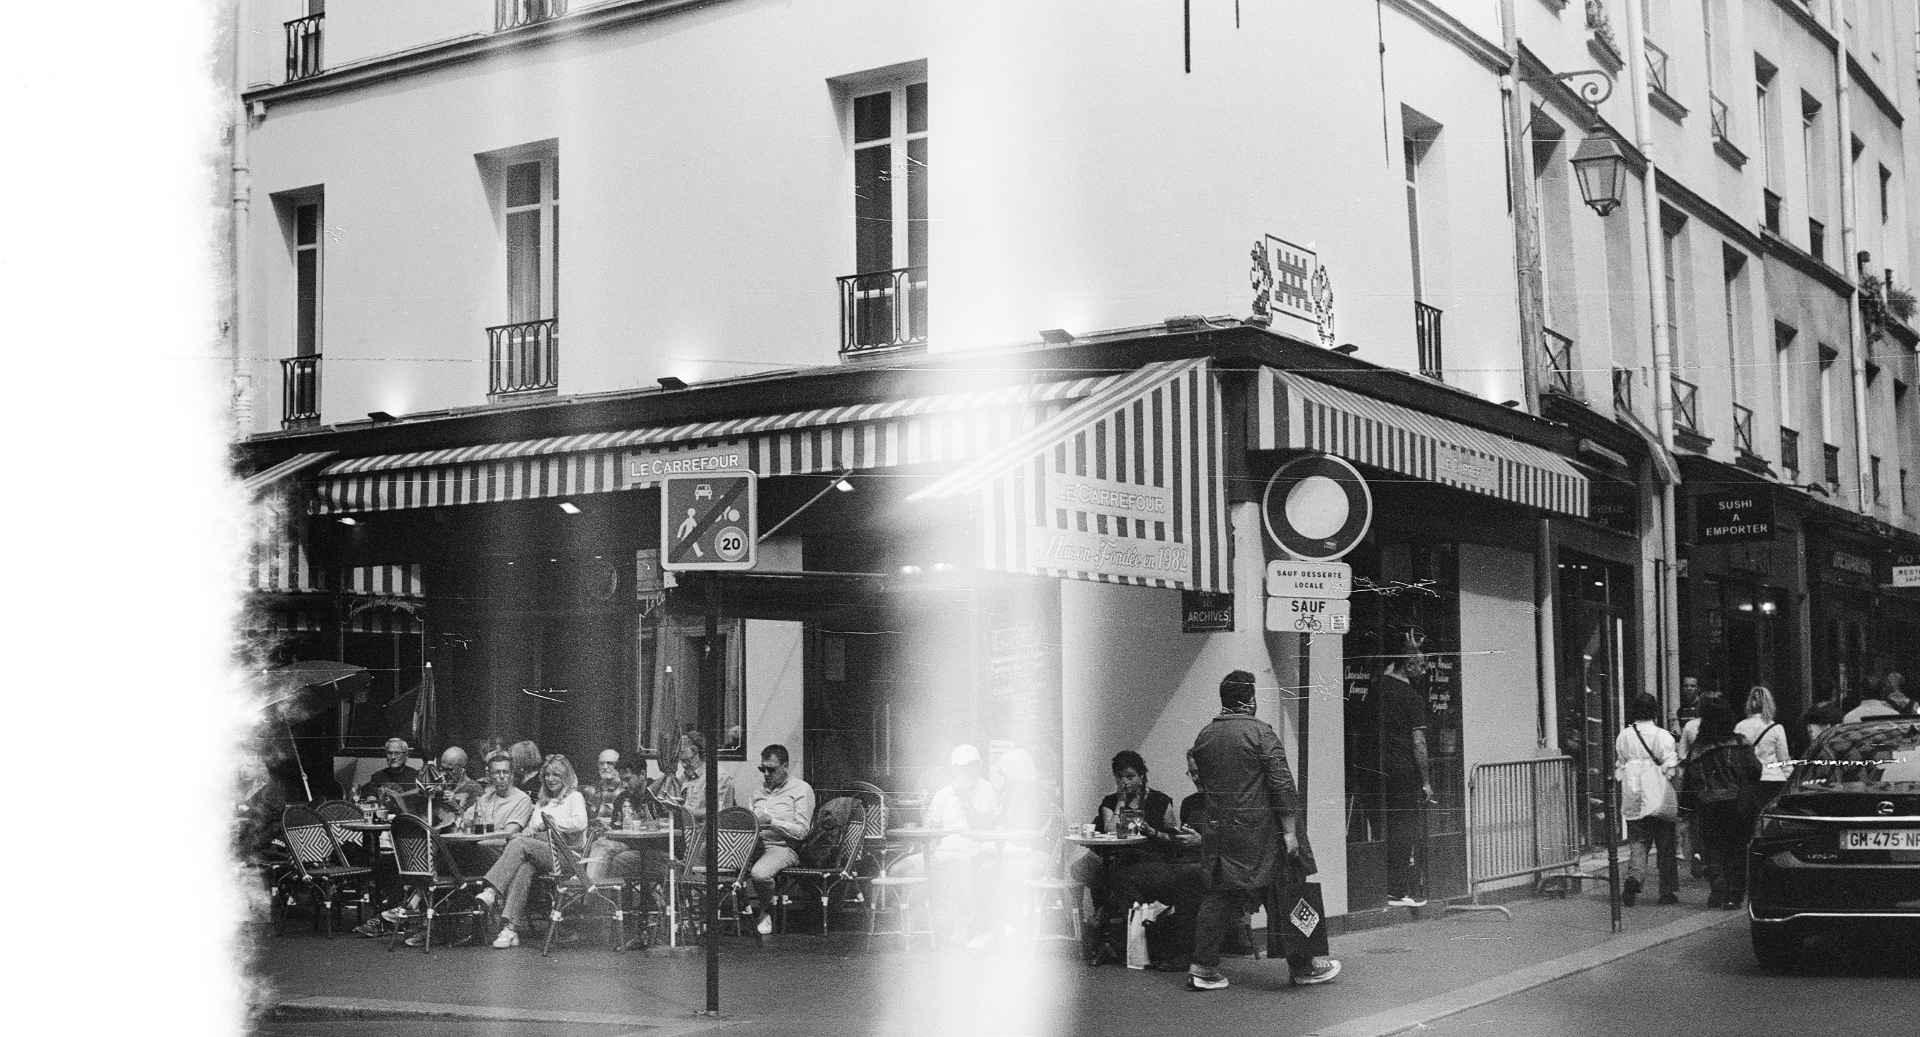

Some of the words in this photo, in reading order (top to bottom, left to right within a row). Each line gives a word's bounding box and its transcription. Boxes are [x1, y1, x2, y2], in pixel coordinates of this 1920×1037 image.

[631, 462, 648, 477] LE
[652, 454, 739, 473] CARREFOUR
[1078, 483, 1167, 512] CARREFOUR
[1718, 499, 1752, 510] SUSHI
[1732, 513, 1740, 522] A
[1705, 523, 1768, 536] EMPORTER
[722, 538, 741, 551] 20
[1158, 545, 1189, 571] 1982
[1291, 600, 1326, 613] SAUF
[1187, 609, 1229, 623] ARCHIVES
